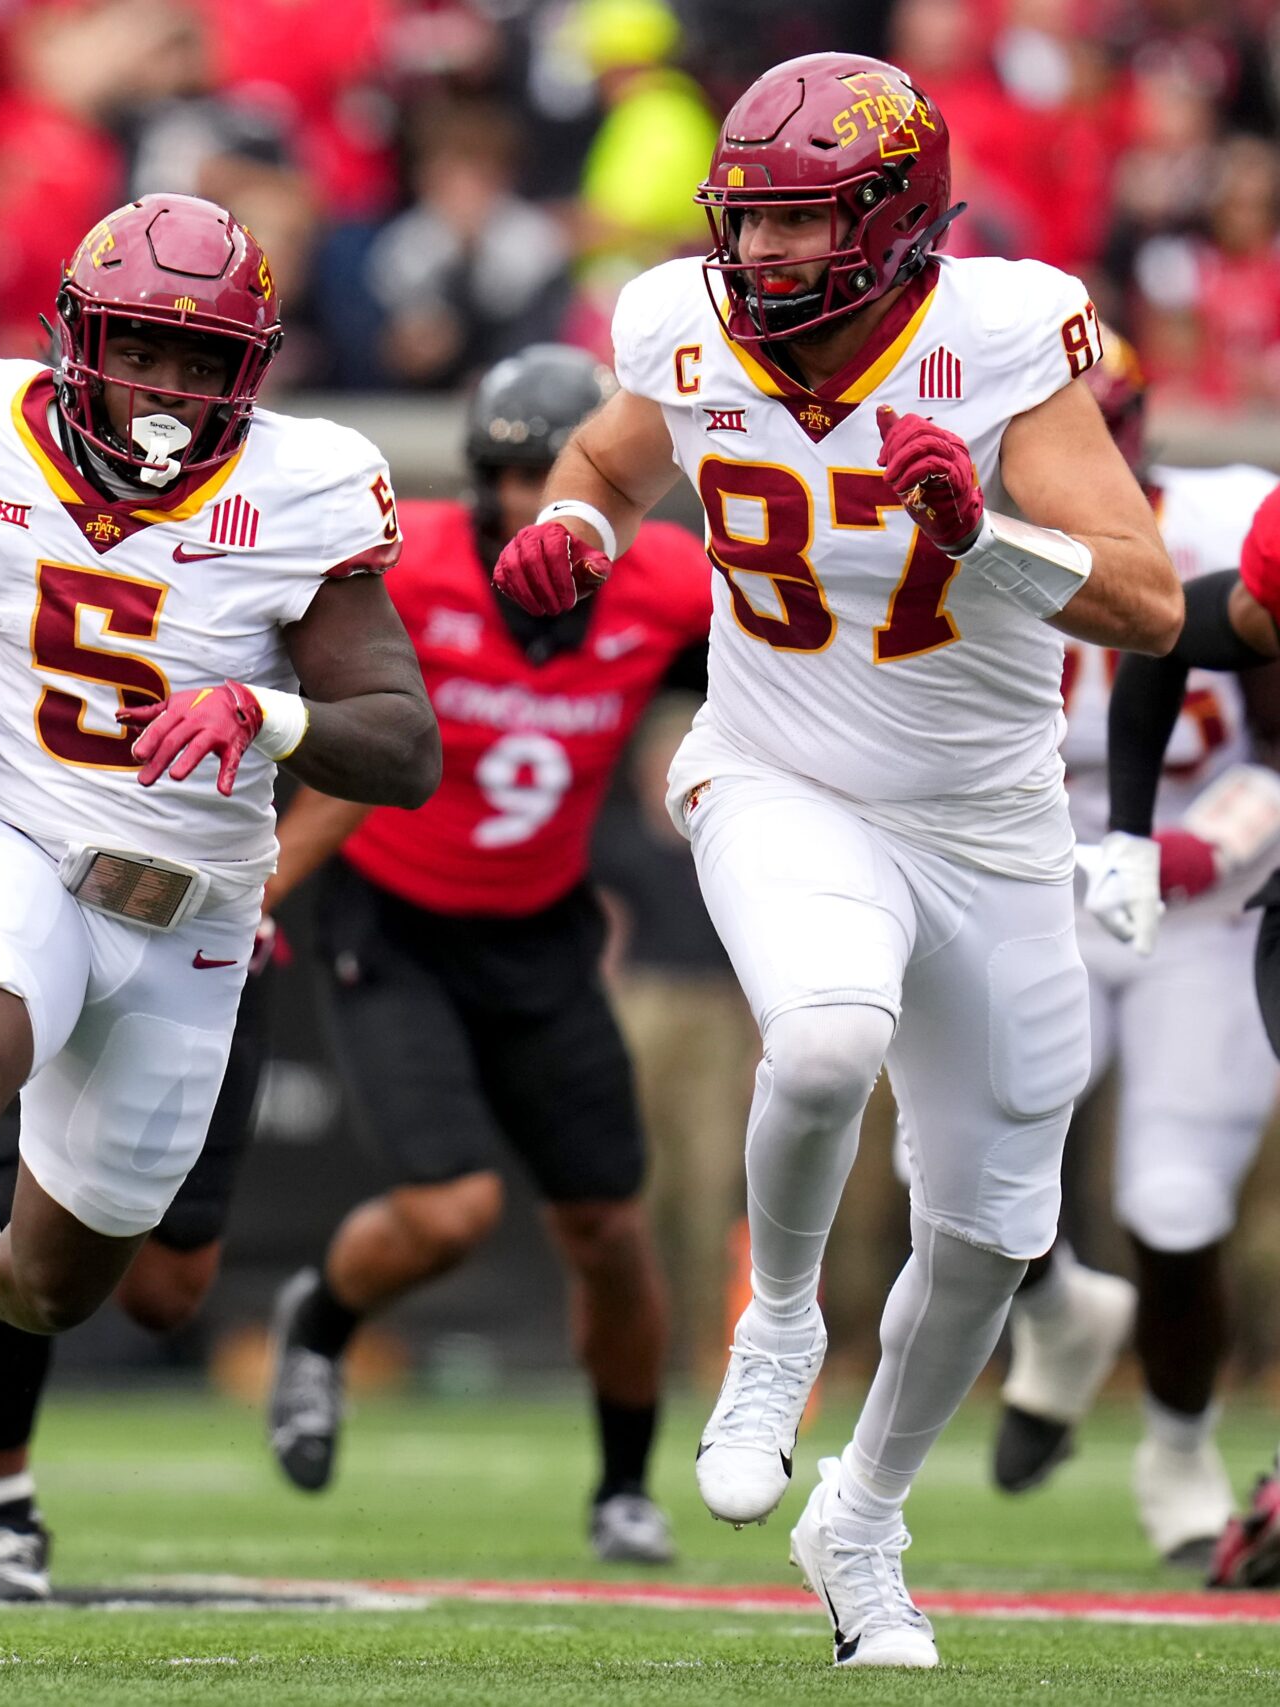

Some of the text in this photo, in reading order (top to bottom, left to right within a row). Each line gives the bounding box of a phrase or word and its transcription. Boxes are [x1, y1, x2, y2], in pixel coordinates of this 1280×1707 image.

[832, 94, 936, 148] STATE
[675, 344, 702, 396] C
[703, 409, 747, 433] XII
[799, 411, 831, 427] STATE
[85, 522, 121, 537] STATE
[698, 453, 977, 665] 87
[29, 558, 172, 773] 5
[470, 732, 572, 848] 9
